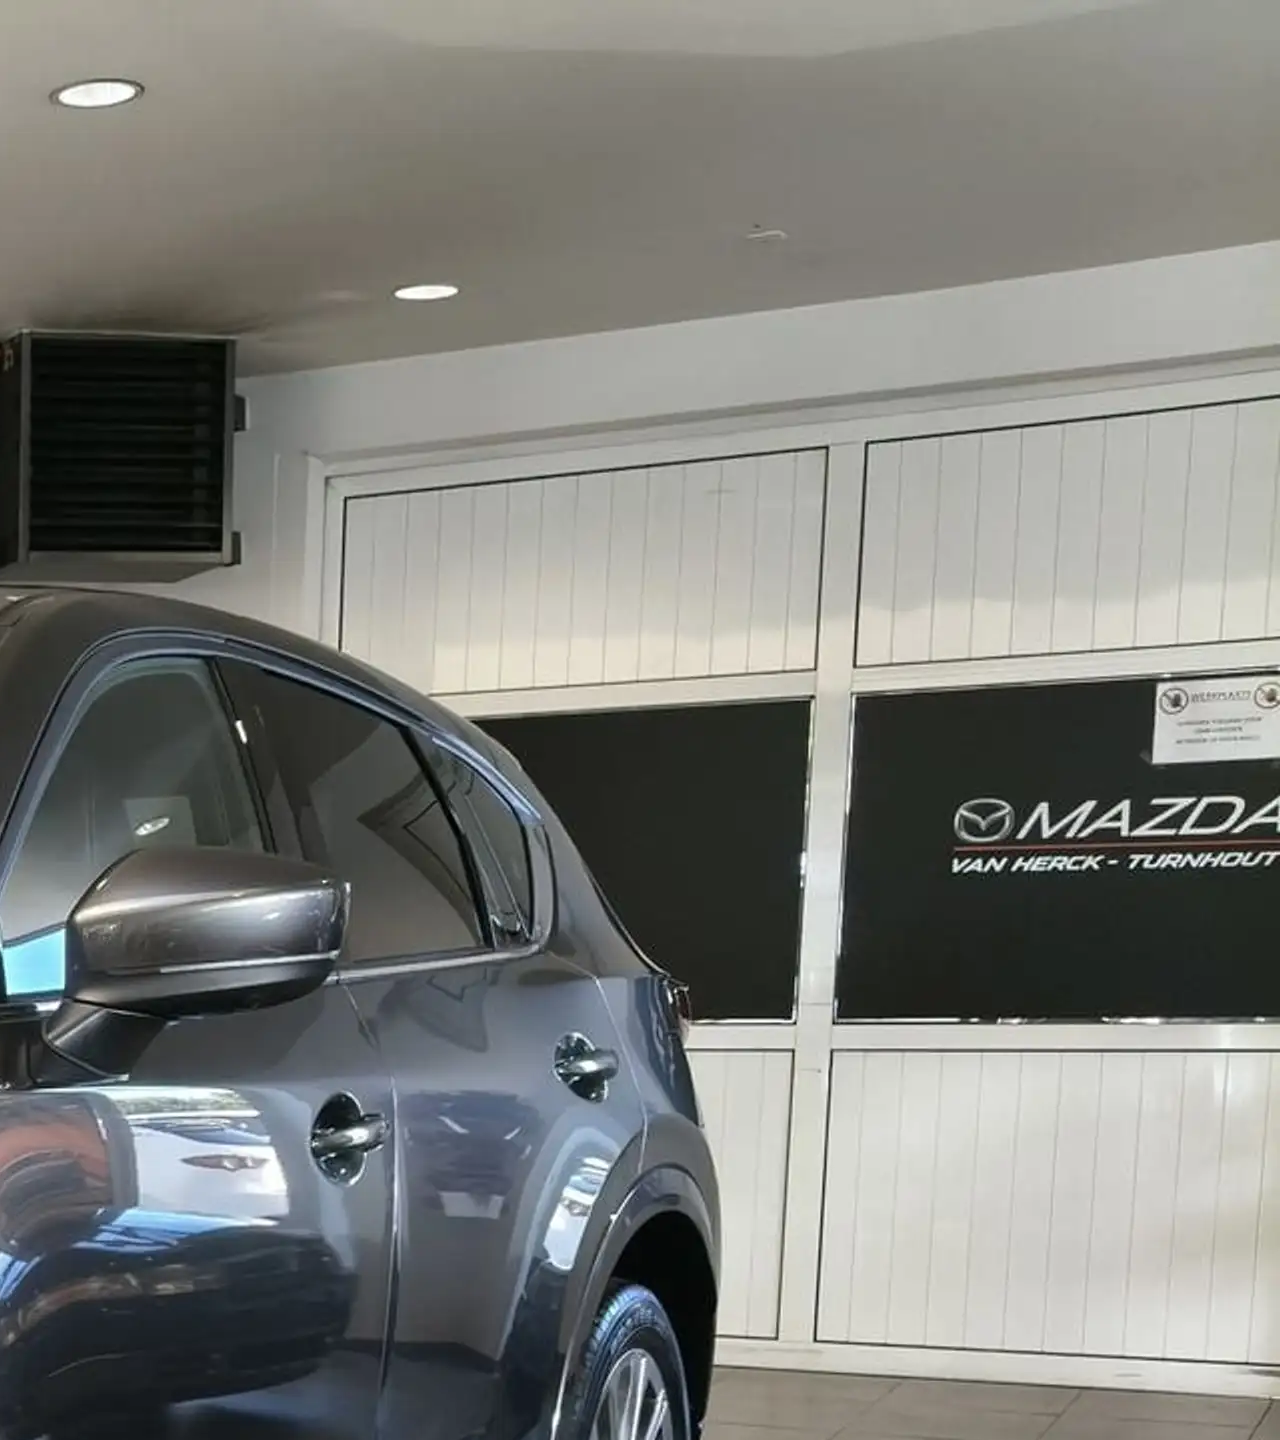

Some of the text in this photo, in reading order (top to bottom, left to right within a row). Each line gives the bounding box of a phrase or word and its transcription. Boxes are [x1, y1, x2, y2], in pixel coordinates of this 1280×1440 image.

[1015, 795, 1280, 840] MAZDA
[951, 856, 1006, 873] VAN
[1011, 854, 1104, 872] HERCK
[1128, 850, 1280, 870] TURNHOUT
